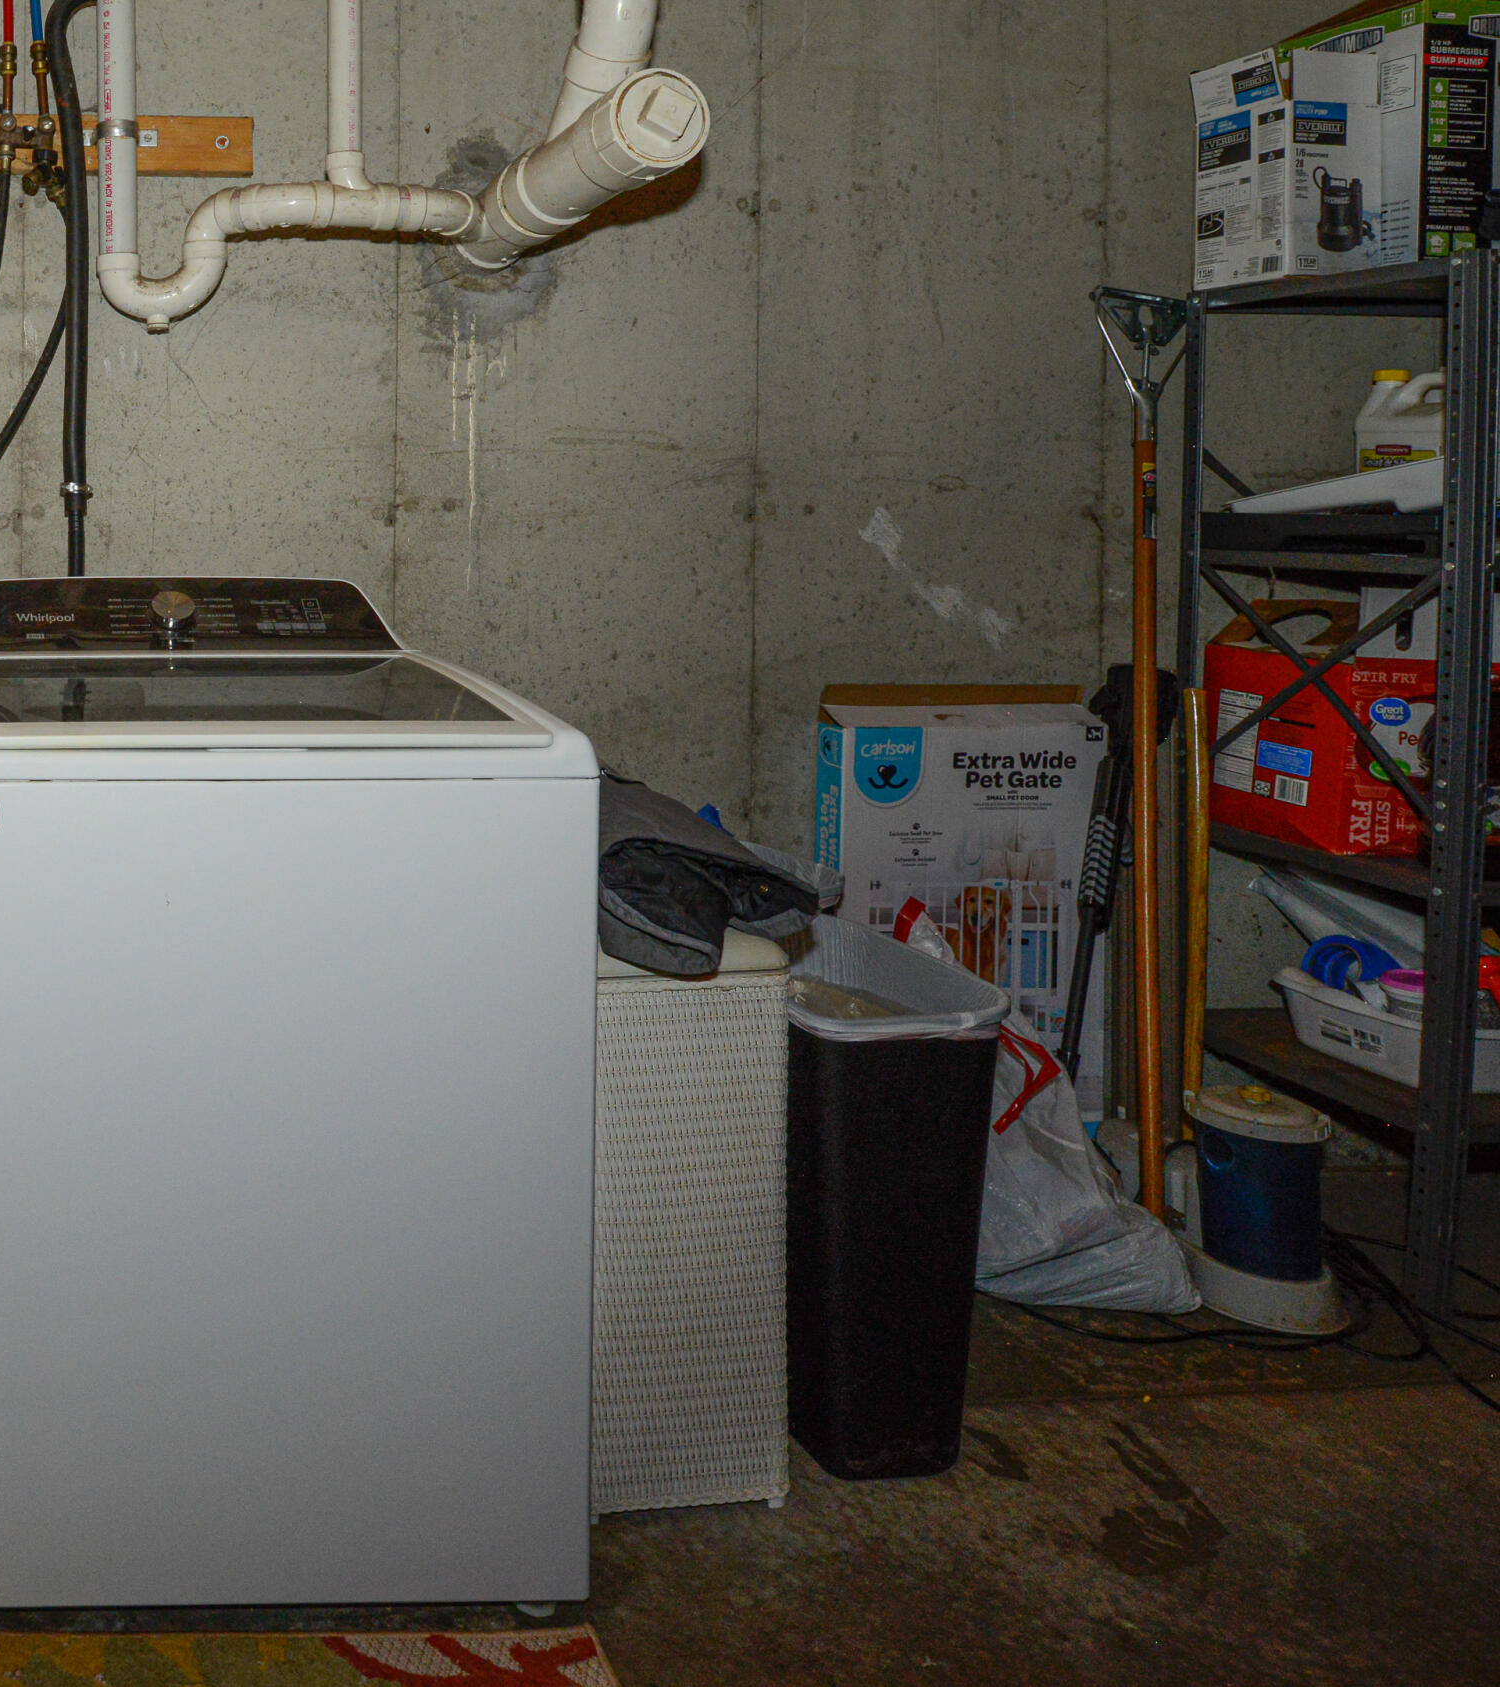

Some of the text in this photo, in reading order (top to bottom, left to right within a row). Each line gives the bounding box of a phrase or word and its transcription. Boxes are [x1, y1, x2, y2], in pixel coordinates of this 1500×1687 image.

[1430, 46, 1489, 56] SUBMERSIBLE
[1430, 56, 1484, 66] SUMP PUMP
[1298, 121, 1341, 131] EVERBILT
[15, 613, 75, 624] Whirlpool
[1352, 671, 1418, 685] STIR FRY
[1375, 703, 1404, 715] Great
[1382, 713, 1404, 721] Value
[1398, 731, 1420, 746] Pe
[861, 738, 916, 757] carlson
[952, 750, 1077, 769] Extra Wide
[965, 771, 1062, 788] Pet Gate
[820, 792, 831, 823] Pet
[829, 785, 838, 834] Extra
[1349, 800, 1372, 847] FRY
[1375, 800, 1391, 845] STIR
